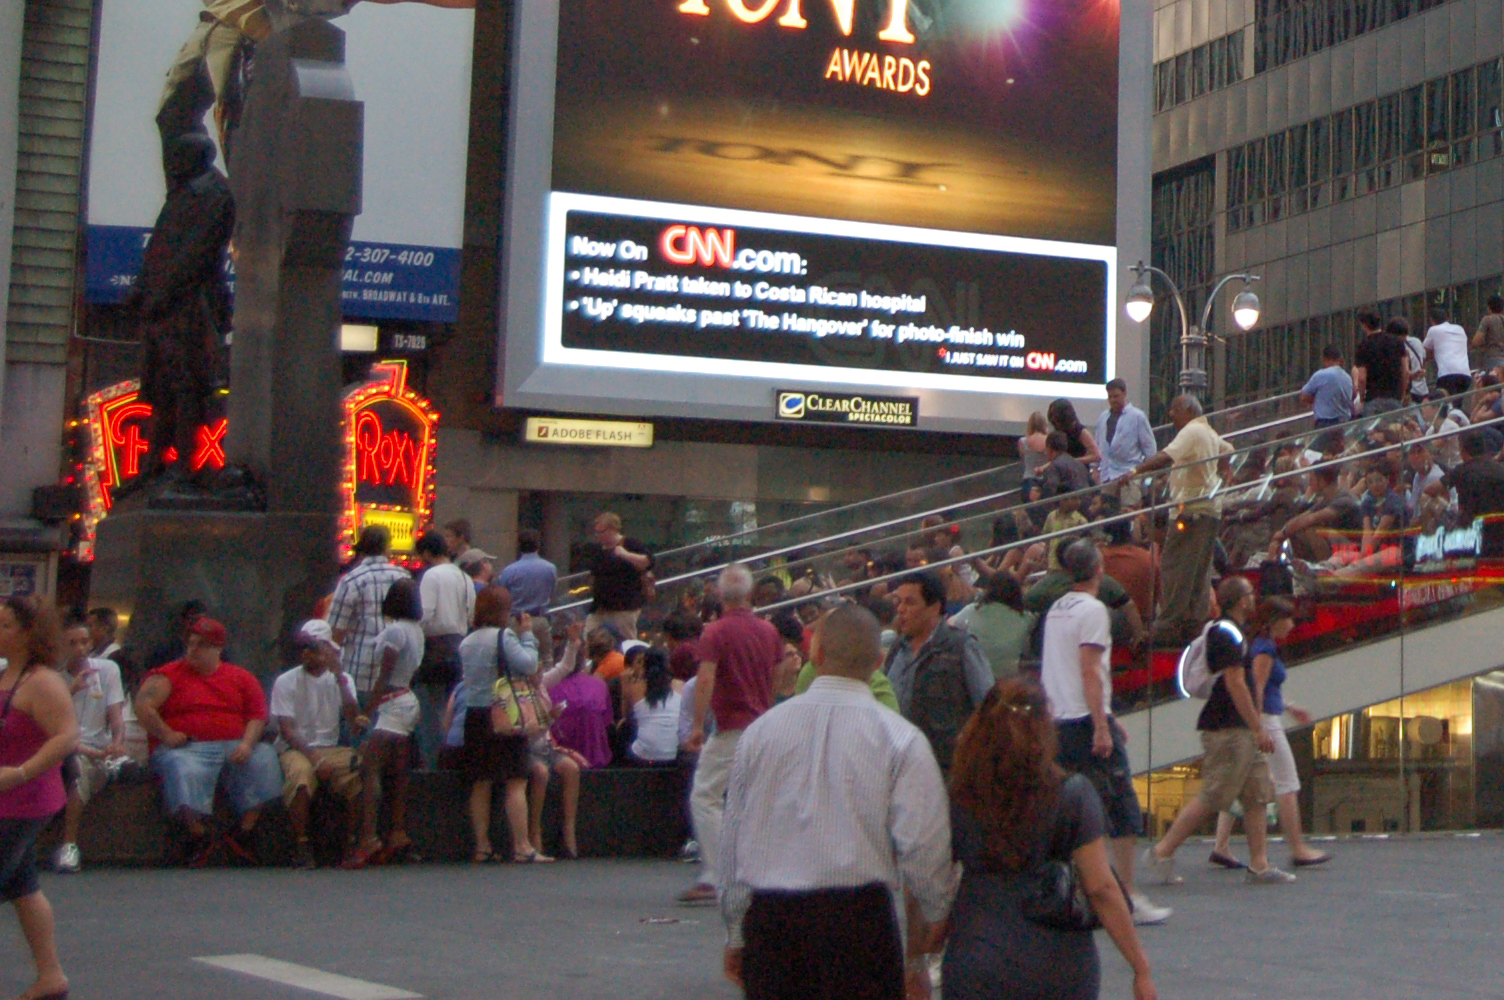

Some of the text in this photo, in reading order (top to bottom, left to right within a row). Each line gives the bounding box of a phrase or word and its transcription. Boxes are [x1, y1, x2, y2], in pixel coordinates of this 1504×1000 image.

[825, 46, 932, 96] AWARDS
[344, 246, 435, 266] 2-307-4100
[571, 235, 615, 258] Now
[617, 240, 648, 261] On
[342, 269, 394, 284] AL.COM
[583, 266, 926, 314] Heidi Pratt taken to Costa Rican hospital
[621, 303, 697, 324] squeaks
[700, 308, 740, 328] past
[872, 320, 896, 339] for
[897, 323, 993, 347] photo-finish
[996, 330, 1025, 349] win
[551, 428, 632, 441] ADOBE FLASH
